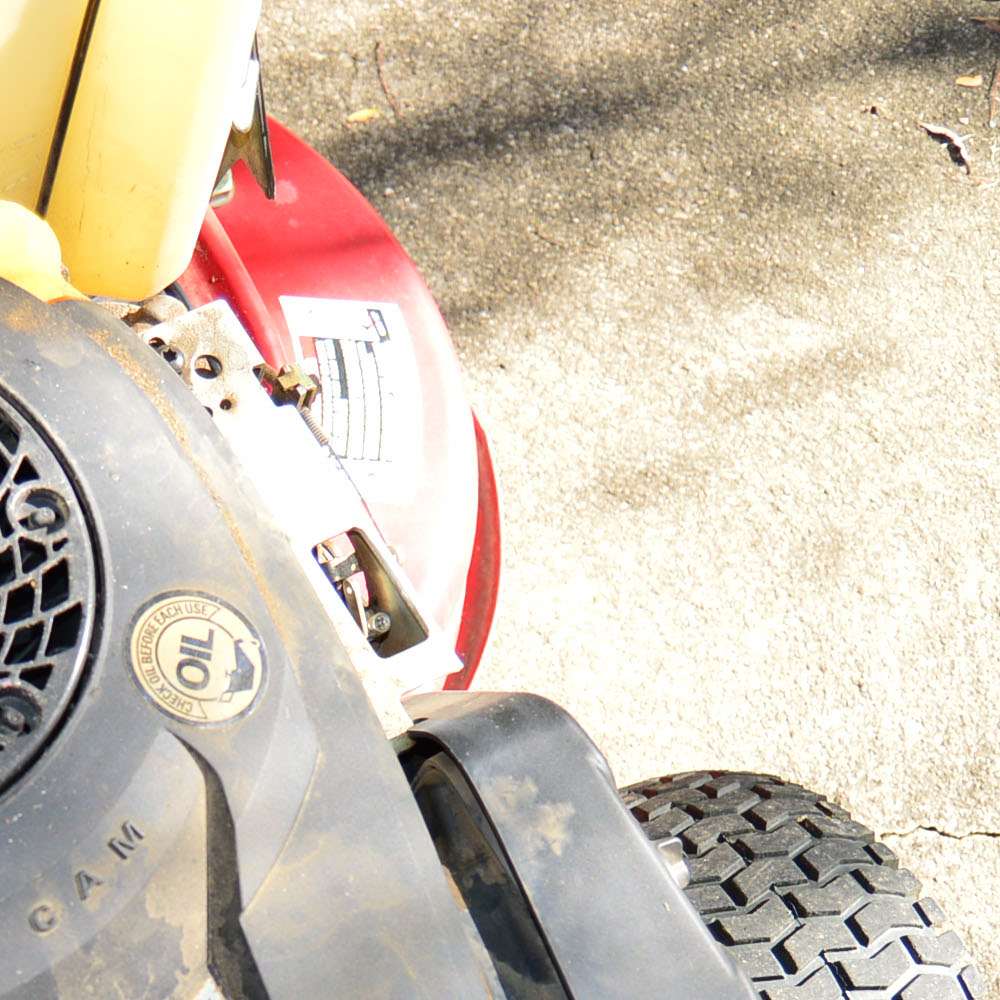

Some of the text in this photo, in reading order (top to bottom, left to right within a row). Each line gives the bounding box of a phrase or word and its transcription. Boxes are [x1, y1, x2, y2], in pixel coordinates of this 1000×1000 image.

[140, 602, 208, 713] CHECK OIL BEFORE EACH USE
[176, 628, 215, 691] OIL
[27, 819, 146, 934] CAM
